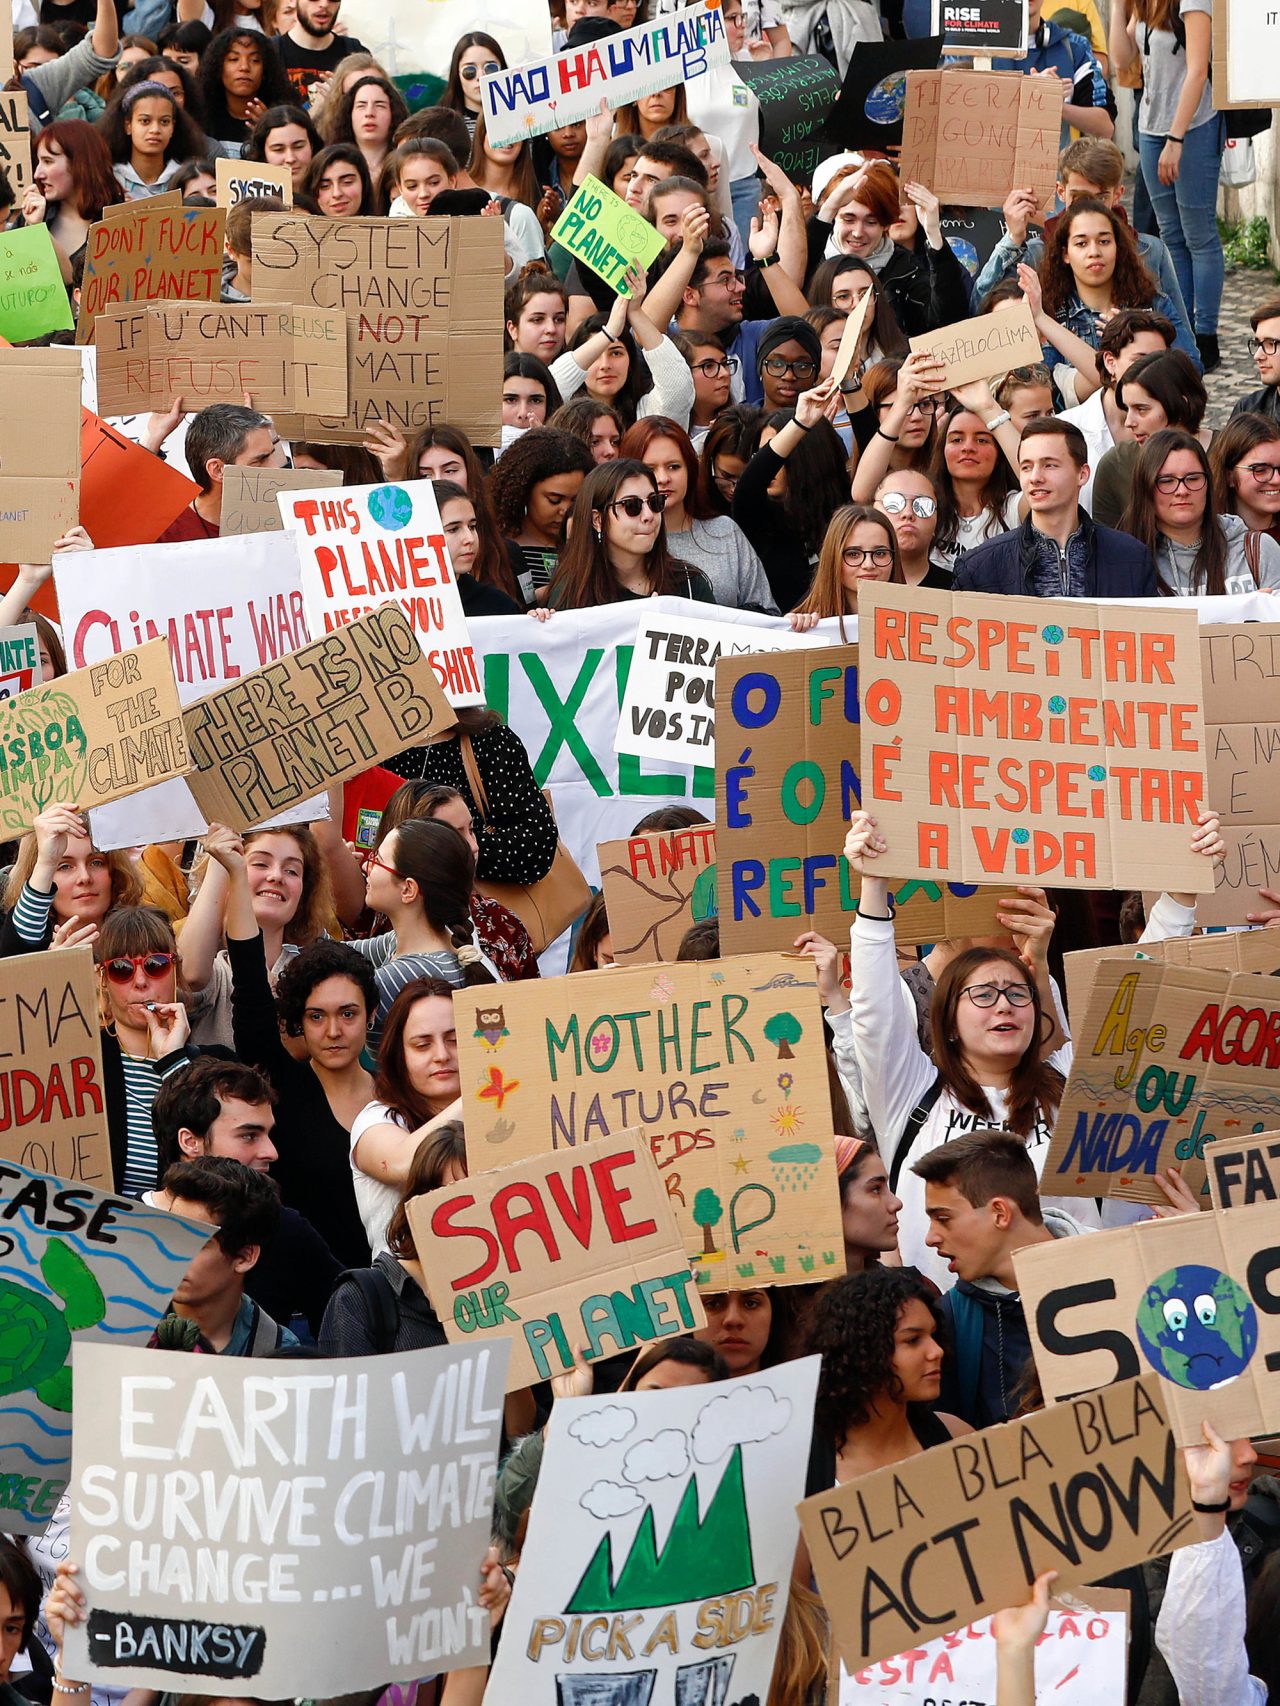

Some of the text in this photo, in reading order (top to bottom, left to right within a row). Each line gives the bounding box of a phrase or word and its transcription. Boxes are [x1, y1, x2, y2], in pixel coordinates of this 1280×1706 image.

[944, 7, 981, 21] RISE
[964, 20, 1000, 29] CLIMATE
[557, 37, 651, 95] HÁ UM
[682, 46, 707, 81] B
[913, 79, 1045, 111] FIZERAM
[574, 190, 602, 221] NO
[93, 217, 218, 259] DON'T FUCK
[255, 222, 451, 270] SYSTEM
[558, 212, 629, 279] PLANET
[87, 268, 219, 314] OUR PLANET
[310, 273, 451, 309] CHANGE
[115, 313, 337, 351] IF CAN'T REUSE
[357, 313, 431, 345] NOT
[126, 357, 318, 398] REFUSE IT
[293, 498, 360, 536] THIS
[314, 533, 452, 598] PLANET
[404, 597, 445, 633] YOU
[90, 653, 142, 697] FOR
[182, 662, 302, 775] THERE
[299, 634, 363, 709] IS
[351, 606, 422, 681] NO
[106, 686, 161, 733] THE
[88, 717, 189, 795] CLIMATE
[220, 693, 379, 823] PLANET
[545, 993, 755, 1081] MOTHER
[550, 1081, 731, 1150] NATURE
[1135, 1064, 1196, 1116] OU
[1056, 1110, 1171, 1176] NADA
[431, 1149, 658, 1291] SAVE
[452, 1280, 521, 1333] OUR
[522, 1268, 697, 1380] PLANET
[119, 1349, 502, 1468] EARTH WILL
[818, 1379, 1165, 1561] BLA BLA BLA
[77, 1451, 497, 1546] SURVIVE CLIMATE
[860, 1427, 1178, 1657] ACT NOW
[370, 1537, 439, 1609] WE
[385, 1584, 490, 1666] WON'T
[526, 1582, 778, 1664] PICK SIDE
